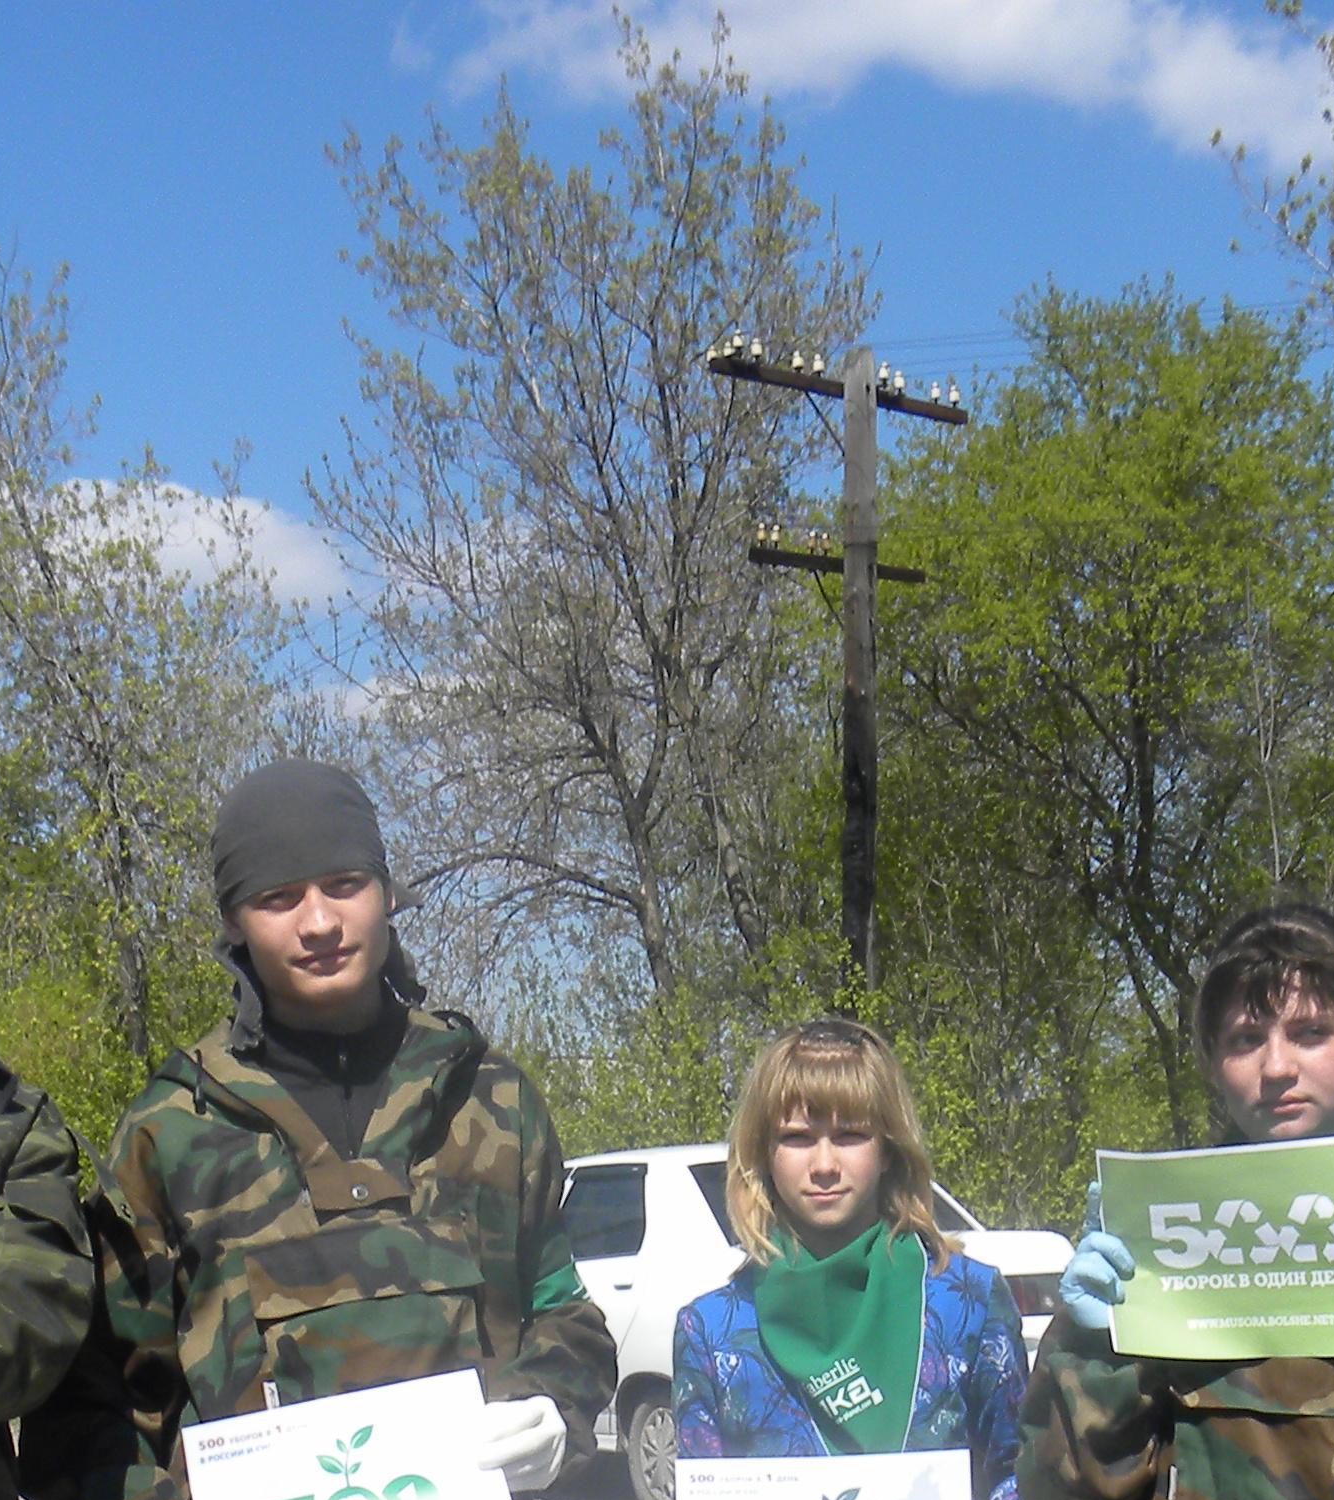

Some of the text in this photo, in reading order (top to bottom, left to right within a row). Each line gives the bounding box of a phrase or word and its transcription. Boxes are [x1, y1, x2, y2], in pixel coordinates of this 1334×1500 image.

[1160, 1273, 1236, 1292] УБОРОК
[1239, 1272, 1250, 1288] В
[1254, 1271, 1307, 1289] ОДИН
[804, 1358, 859, 1394] aberlic
[198, 1437, 226, 1451] 500
[689, 1474, 715, 1483] 500
